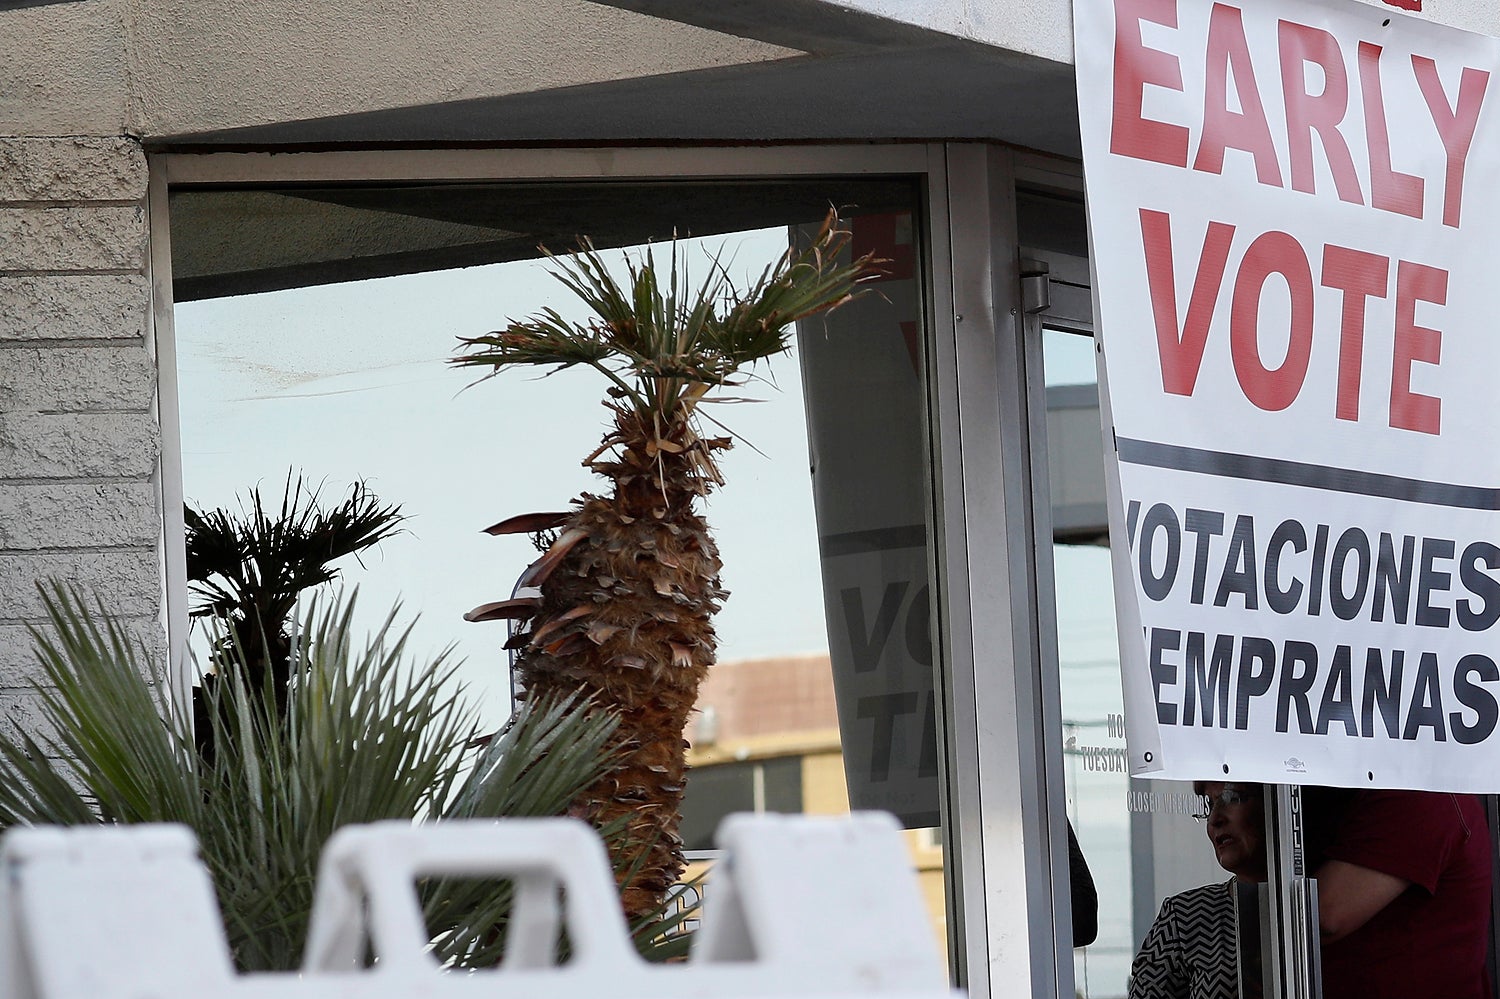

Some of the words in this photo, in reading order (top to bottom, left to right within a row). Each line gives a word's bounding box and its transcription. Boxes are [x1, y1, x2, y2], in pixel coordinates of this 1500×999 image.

[1109, 0, 1491, 230] EARLY
[1138, 208, 1450, 437] VOTE
[1107, 713, 1127, 739] MO
[1143, 626, 1500, 745] EMPRANAS
[1126, 790, 1160, 814] CLOSED
